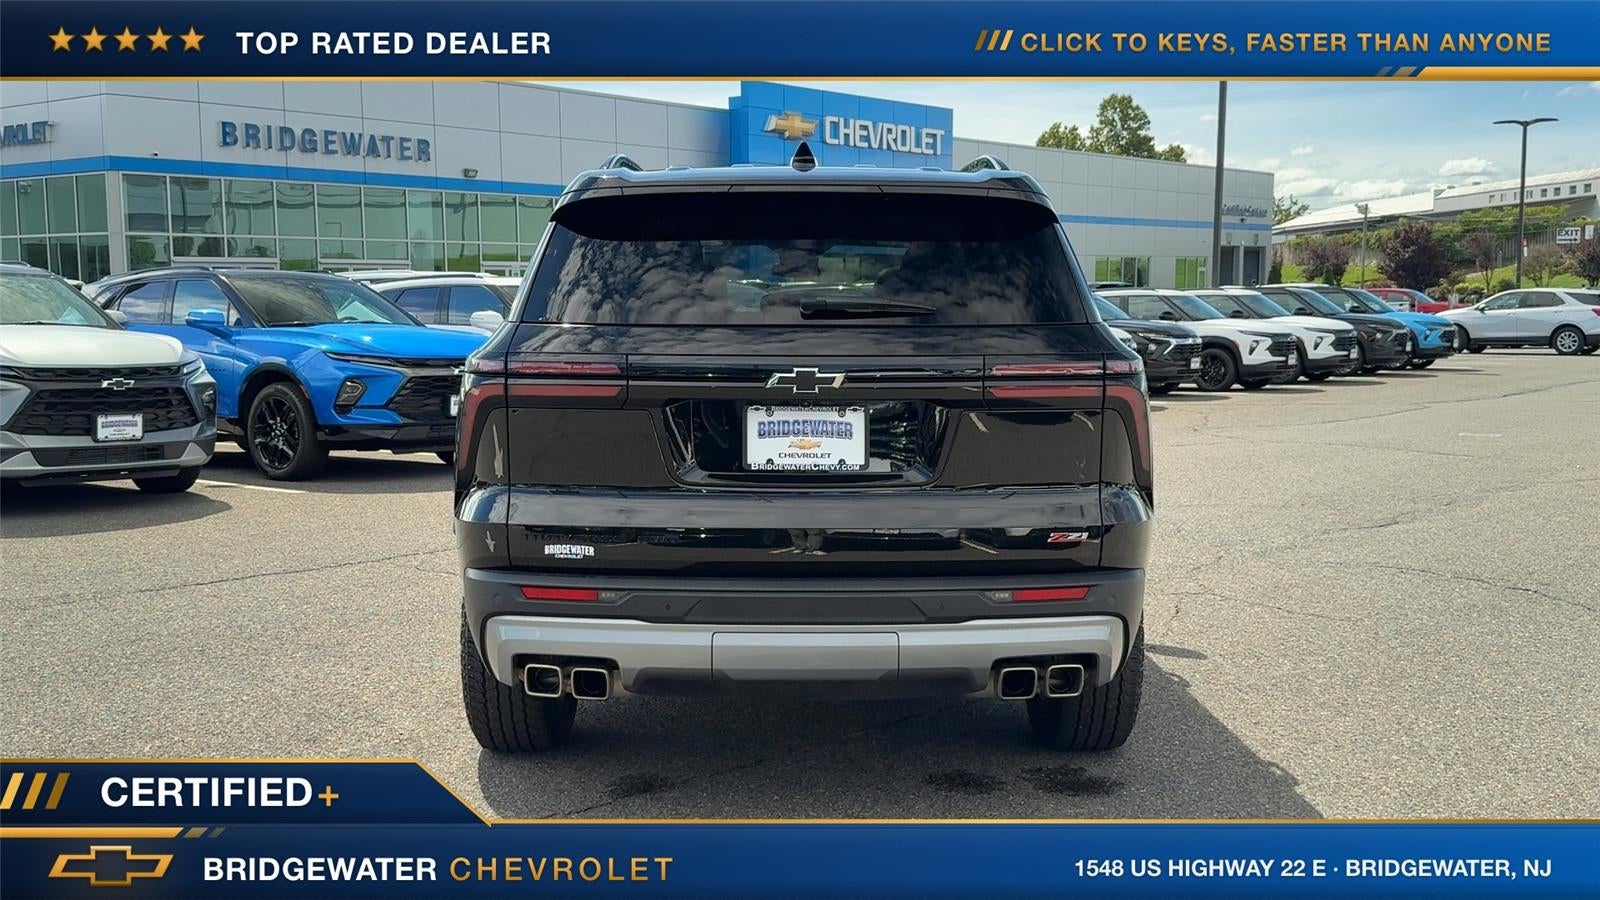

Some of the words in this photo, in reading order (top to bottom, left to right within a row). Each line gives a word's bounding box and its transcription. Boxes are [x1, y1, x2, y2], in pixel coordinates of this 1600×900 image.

[219, 120, 432, 162] BRIDGEWATER
[825, 115, 945, 155] CHEVROLET
[757, 419, 853, 439] BRIDGEWATER
[544, 544, 595, 556] BRIDGEWATER
